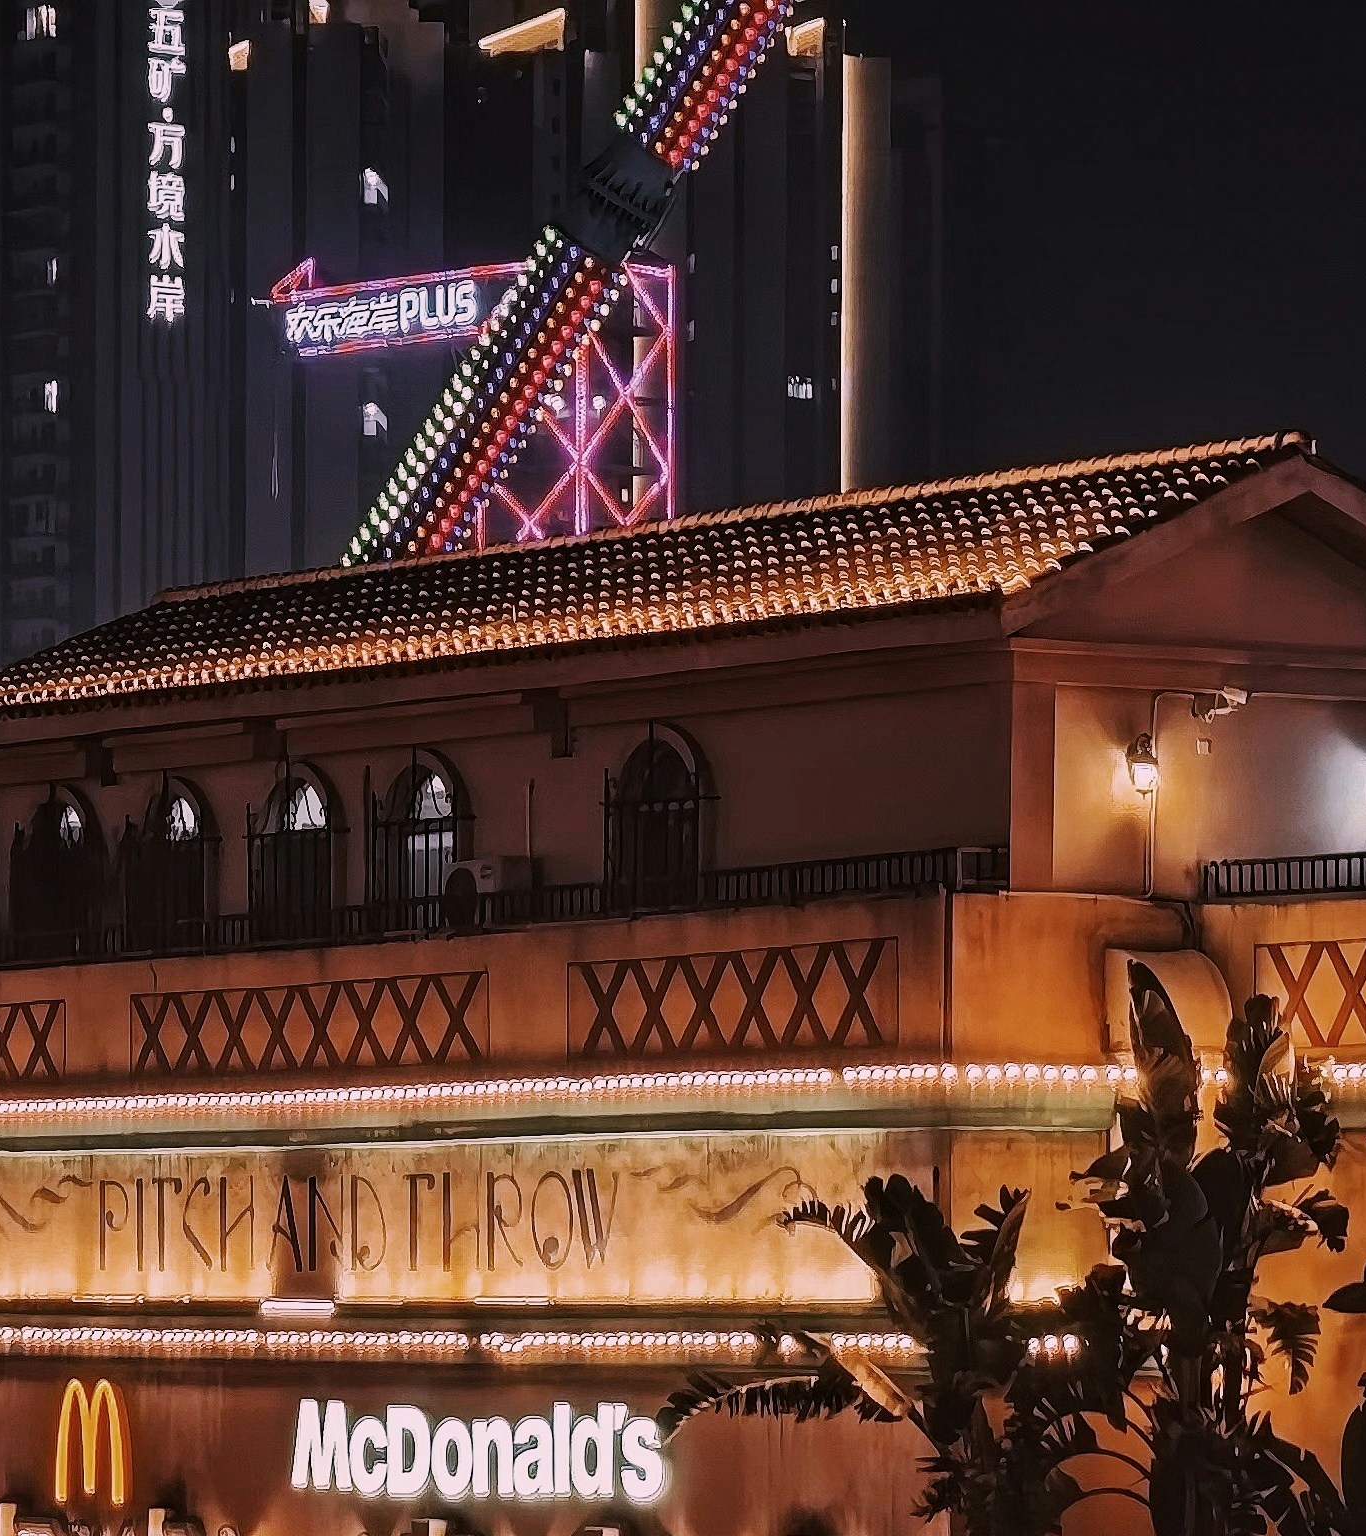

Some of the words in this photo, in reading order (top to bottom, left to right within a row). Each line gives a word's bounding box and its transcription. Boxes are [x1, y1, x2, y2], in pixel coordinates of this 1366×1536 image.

[98, 1173, 256, 1272] PITCH
[265, 1172, 387, 1272] AND
[402, 1168, 620, 1272] THROW
[291, 1398, 667, 1504] McDonald's
